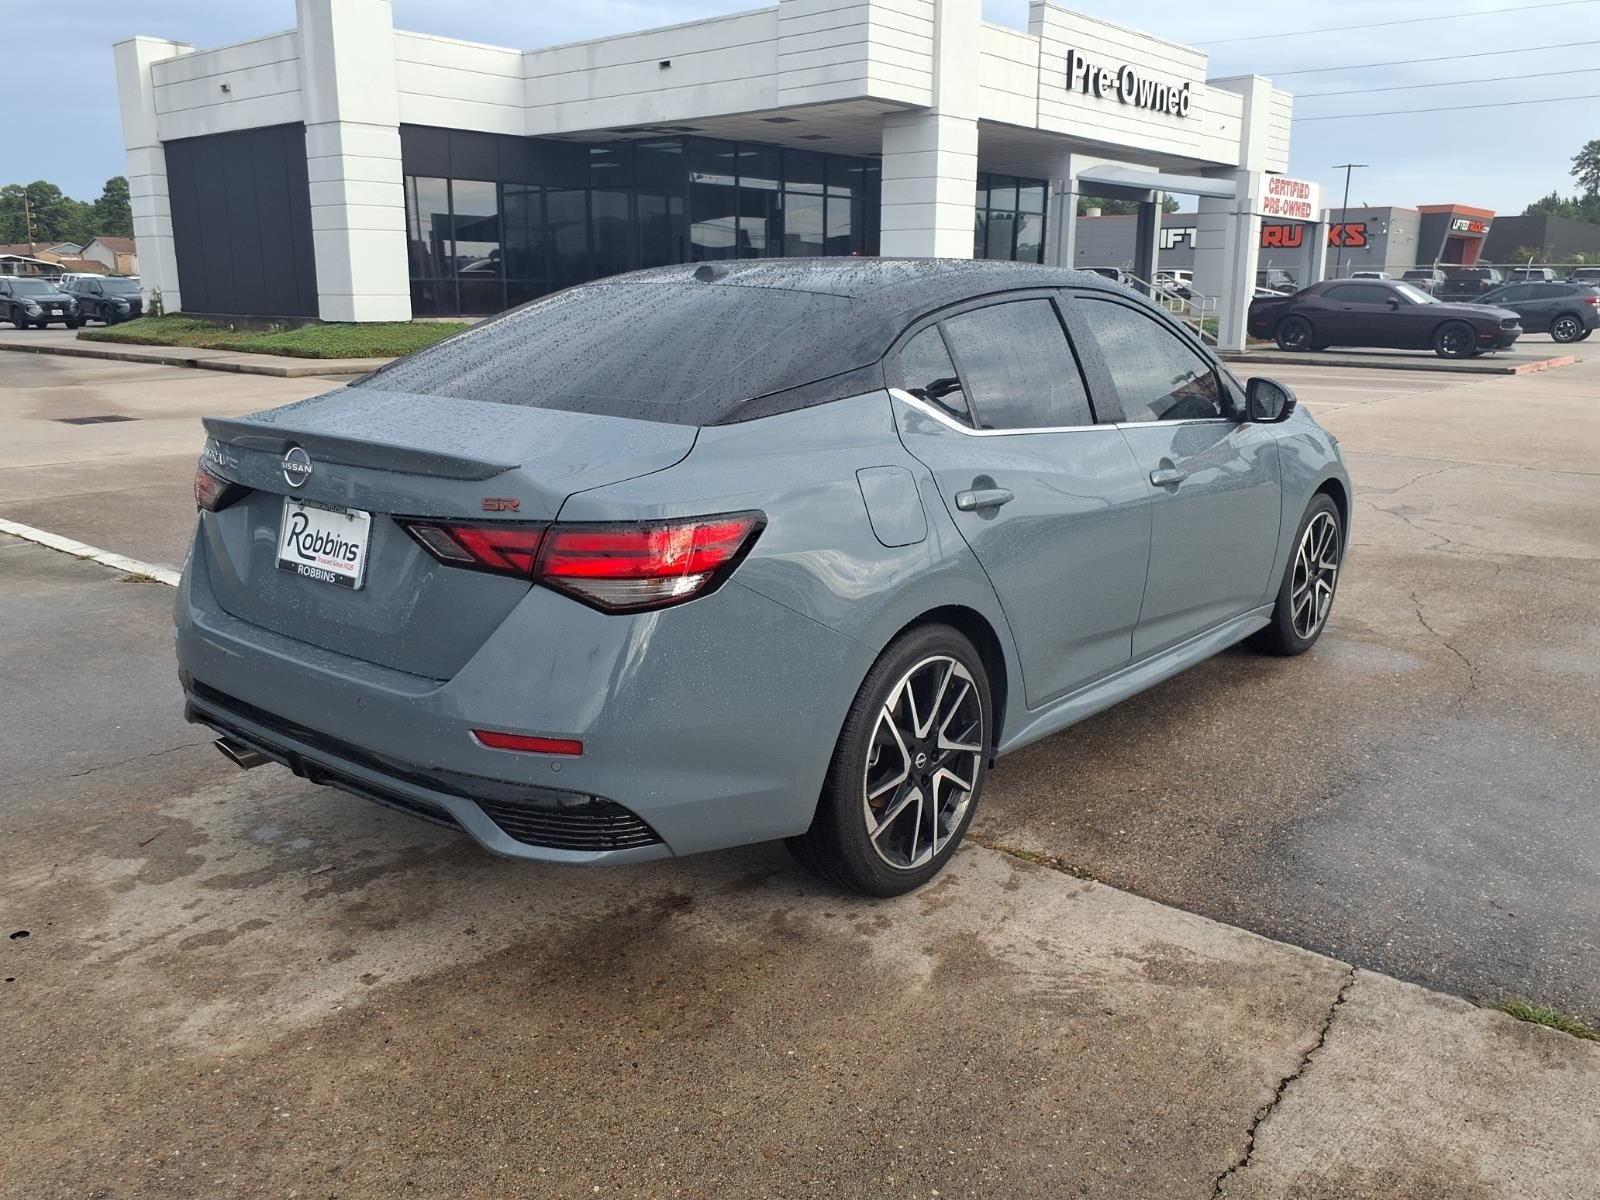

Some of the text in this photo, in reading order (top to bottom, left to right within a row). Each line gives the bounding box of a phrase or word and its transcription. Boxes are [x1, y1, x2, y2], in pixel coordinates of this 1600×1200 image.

[1066, 49, 1192, 118] Pre-Owned
[1268, 177, 1310, 199] CERTIFIED
[1263, 196, 1311, 218] PRE-OWNED
[1160, 223, 1367, 249] IFT RUKS
[281, 461, 312, 474] NISSAN
[480, 496, 520, 512] SR
[287, 512, 359, 561] Robbins
[298, 564, 336, 583] ROBBINS
